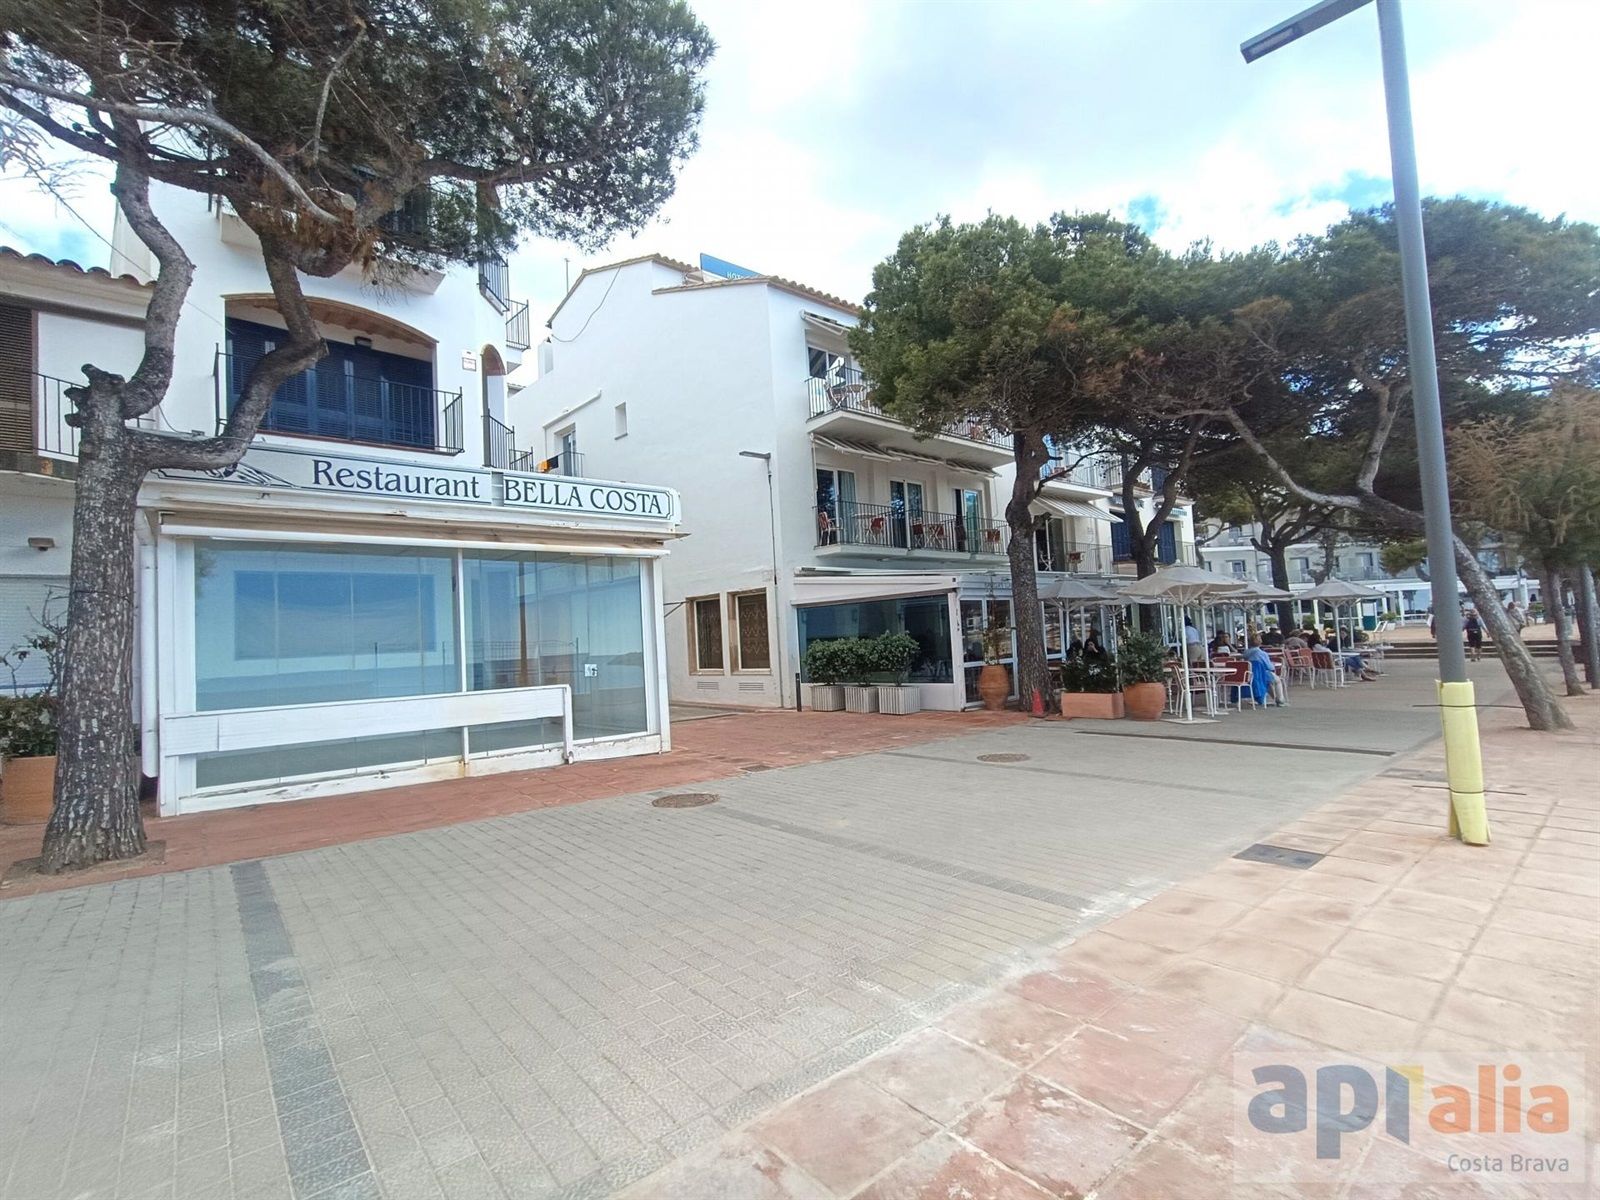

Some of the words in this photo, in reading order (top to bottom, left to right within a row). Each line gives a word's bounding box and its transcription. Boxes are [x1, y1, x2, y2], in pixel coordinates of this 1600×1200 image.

[311, 459, 481, 499] Restaurant
[503, 479, 583, 508] BELLA
[590, 488, 662, 514] COSTA
